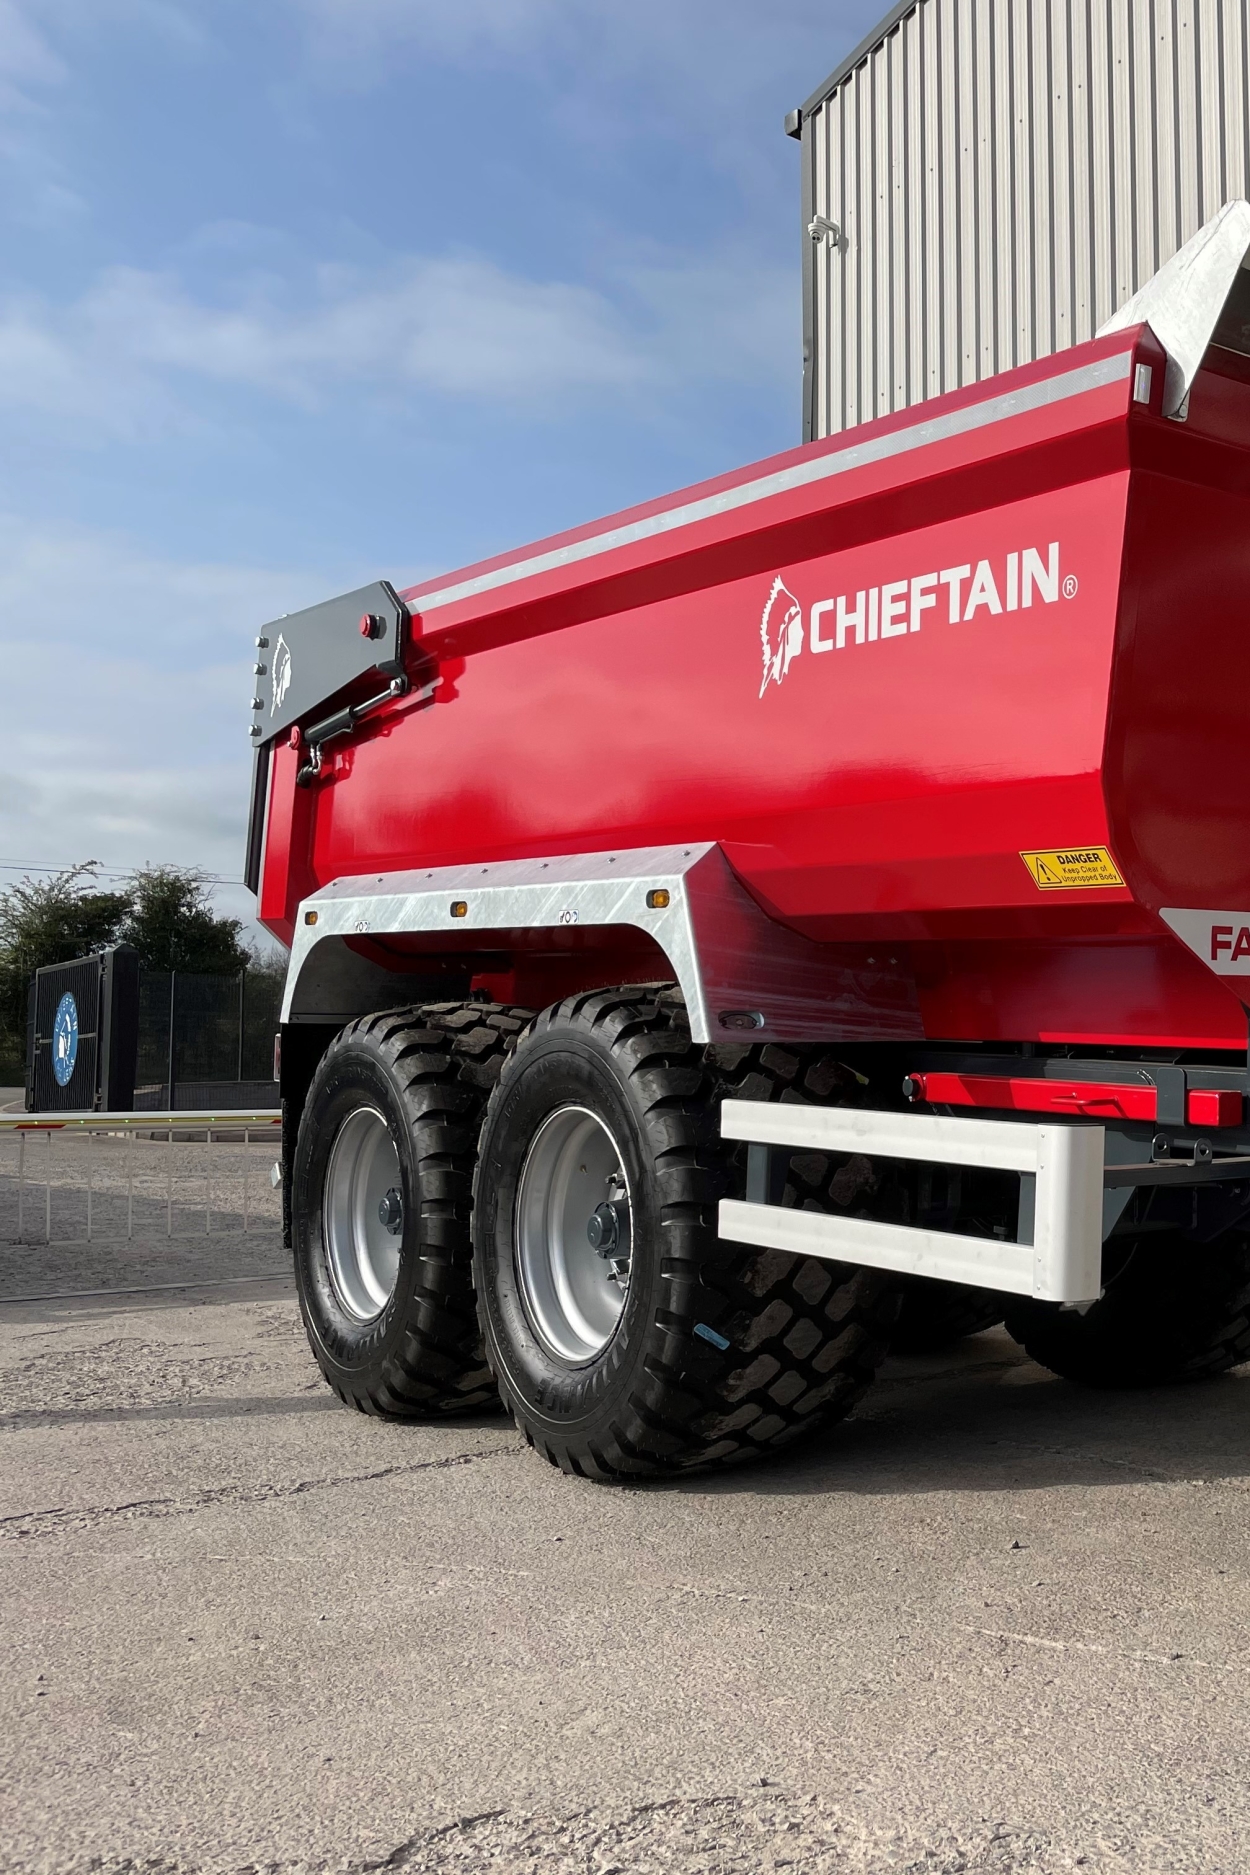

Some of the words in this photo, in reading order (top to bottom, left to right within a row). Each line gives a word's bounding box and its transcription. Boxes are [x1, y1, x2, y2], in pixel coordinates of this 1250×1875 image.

[1056, 852, 1102, 864] DANGER
[1062, 866, 1080, 875] Keep
[1081, 865, 1099, 873] Clear
[1100, 864, 1108, 872] of
[1061, 873, 1099, 883] Unpropped
[1100, 872, 1118, 882] Body
